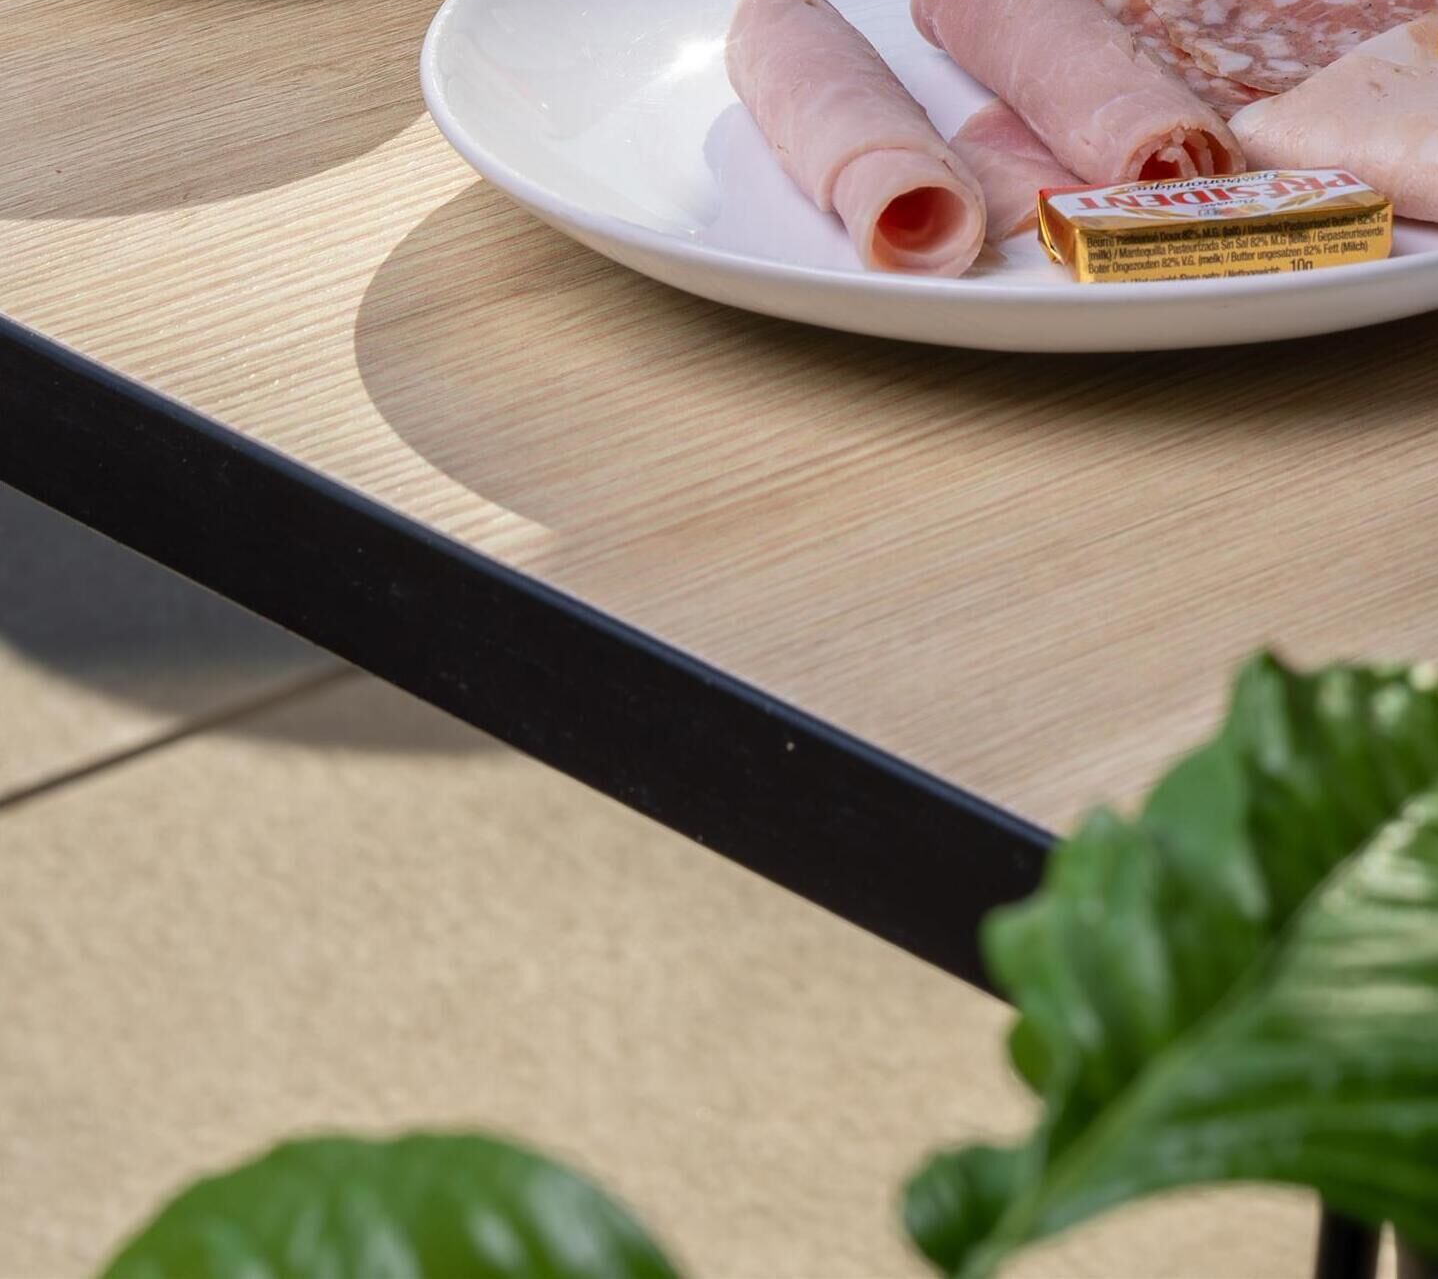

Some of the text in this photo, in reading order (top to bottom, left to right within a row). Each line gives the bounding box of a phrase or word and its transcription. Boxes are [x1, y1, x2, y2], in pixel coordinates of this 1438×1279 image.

[1332, 215, 1356, 227] Butter
[1358, 213, 1376, 225] 82%
[1088, 248, 1112, 261] (milk)
[1119, 245, 1166, 260] Mantequilla
[1167, 240, 1219, 254] Pasteurizada
[1221, 239, 1234, 250] Sin
[1235, 238, 1249, 249] Sal
[1250, 235, 1269, 247] 82%
[1318, 225, 1385, 245] Gepasteuriseerde
[1089, 263, 1110, 274] Boter
[1112, 259, 1160, 274] Ongezouten
[1161, 257, 1181, 268] 82%
[1199, 253, 1223, 267] (melk)
[1231, 250, 1255, 263] Butter
[1257, 246, 1301, 262] ungesalzen
[1303, 244, 1322, 256] 82%
[1323, 242, 1340, 254] Fett
[1341, 240, 1368, 255] (Milch)
